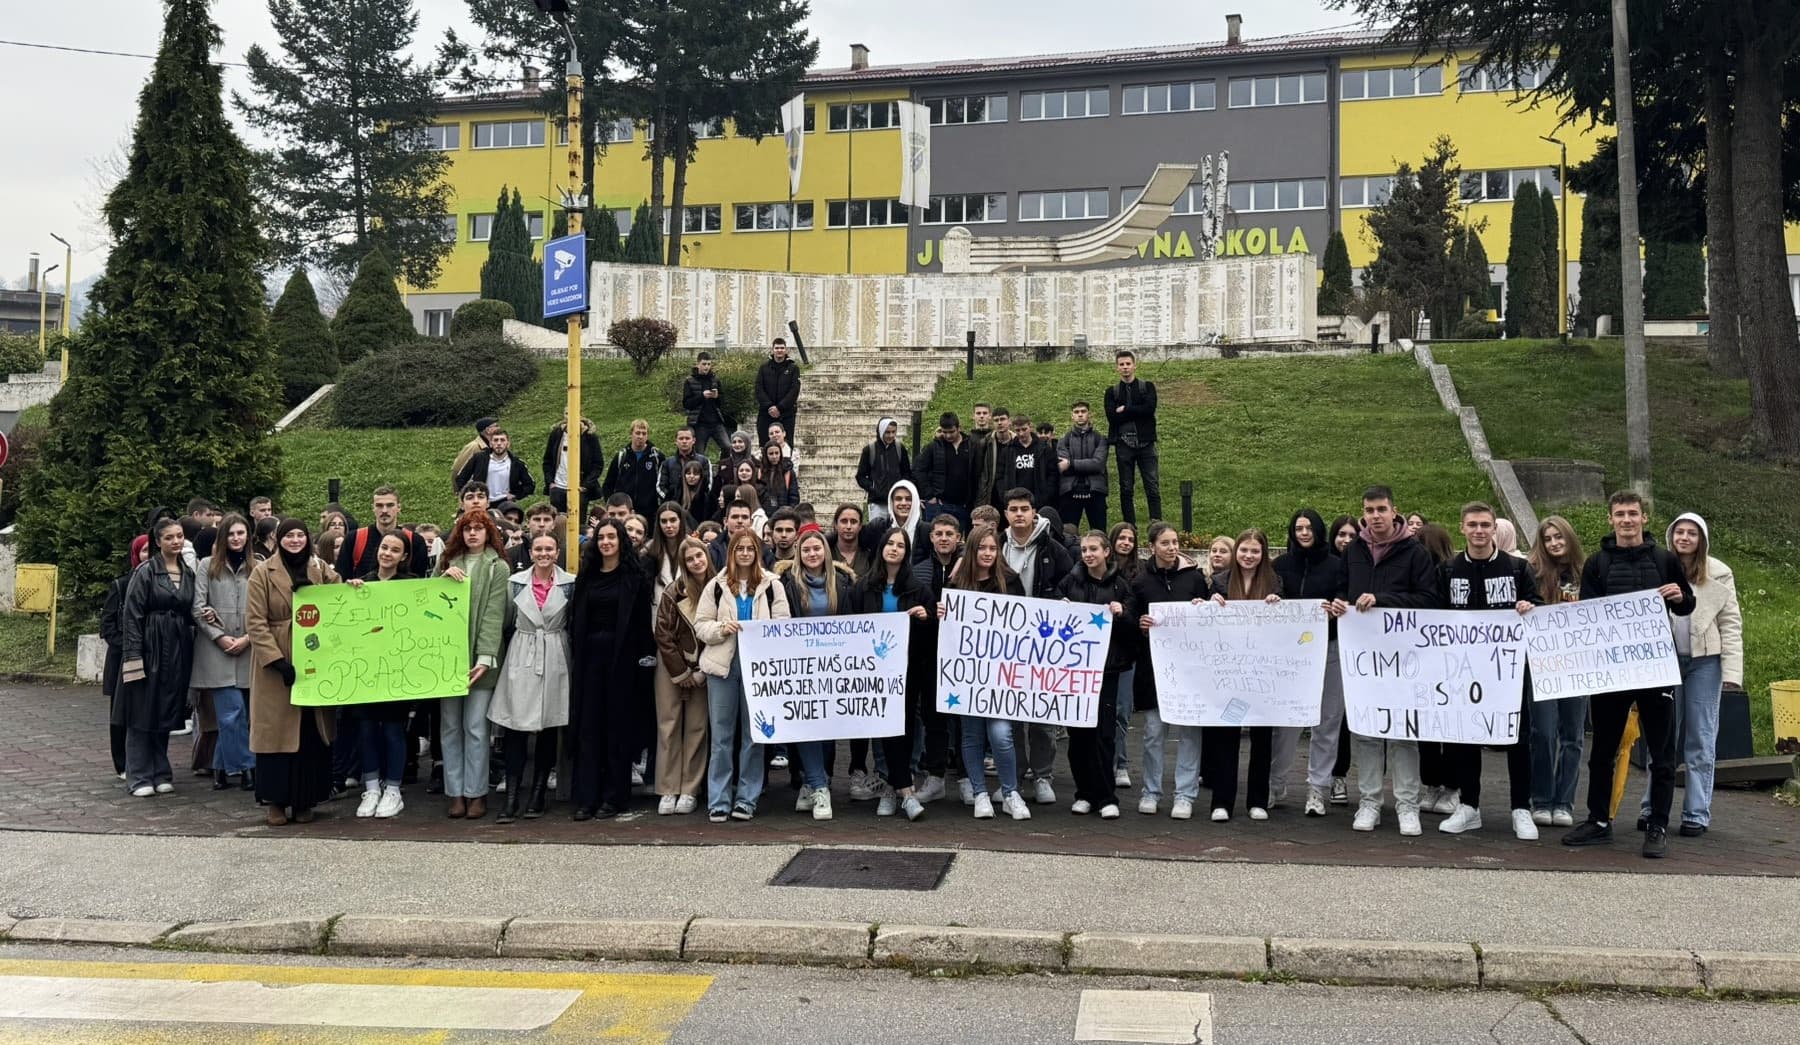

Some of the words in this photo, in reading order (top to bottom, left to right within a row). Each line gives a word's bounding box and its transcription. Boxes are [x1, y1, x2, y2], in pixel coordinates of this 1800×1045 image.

[917, 239, 944, 266] J
[296, 609, 318, 621] STOP
[323, 594, 409, 630] ŽELIMO
[944, 593, 966, 622] MI
[973, 597, 1027, 631] SMO
[1384, 611, 1417, 634] DAN
[1522, 610, 1570, 632] MLADI
[1577, 606, 1598, 625] SU
[1604, 595, 1663, 621] RESURS
[763, 623, 781, 638] DAN
[784, 620, 876, 637] SREDNJOŠKOLACA
[1527, 635, 1559, 653] KOJI
[1564, 625, 1622, 649] DRŽAVA
[1623, 618, 1670, 640] TREBA
[959, 625, 1100, 668] BUDUĆNOST
[1605, 646, 1623, 665] NE
[1624, 640, 1674, 662] PROBLEM
[751, 657, 816, 678] POŠTUJTE
[817, 654, 842, 673] NAŠ
[844, 656, 876, 671] GLAS
[940, 658, 991, 687] KOJU
[997, 661, 1025, 689] NE
[1030, 665, 1103, 694] MOŽETE
[1444, 652, 1473, 681] DA
[1490, 646, 1517, 681] 17
[318, 653, 468, 702] PRAKSU
[795, 678, 816, 695] JER
[818, 678, 833, 695] MI
[836, 677, 884, 695] GRADIMO
[888, 674, 904, 695] VAŠ
[1535, 677, 1562, 695] KOJI
[1568, 671, 1614, 690] TREBA
[1415, 681, 1482, 707] BISMO
[783, 699, 829, 720] SVIJET
[836, 697, 887, 718] SUTRA!
